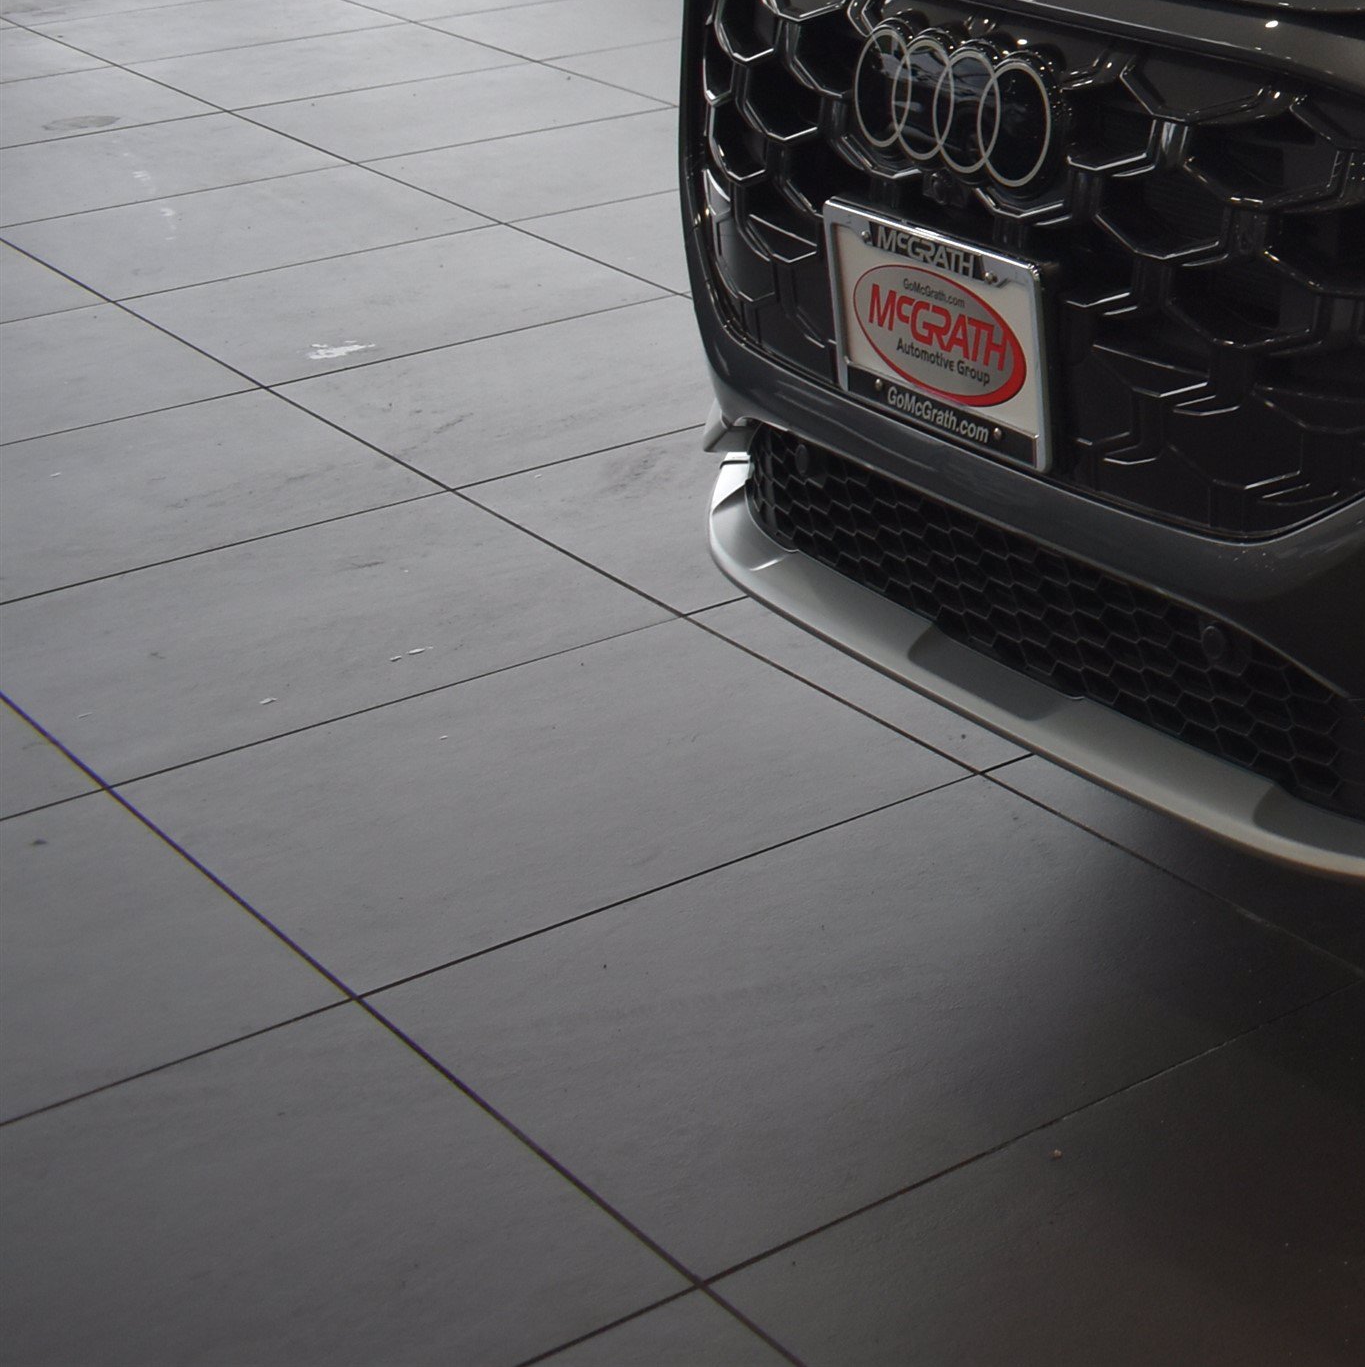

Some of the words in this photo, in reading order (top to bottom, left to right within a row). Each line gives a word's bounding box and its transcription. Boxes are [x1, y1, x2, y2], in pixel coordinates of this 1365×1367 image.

[903, 278, 966, 309] GoMcGrath.com
[896, 338, 955, 371] Automotive
[956, 360, 991, 386] Group
[887, 386, 989, 443] GoMcGrath.com
